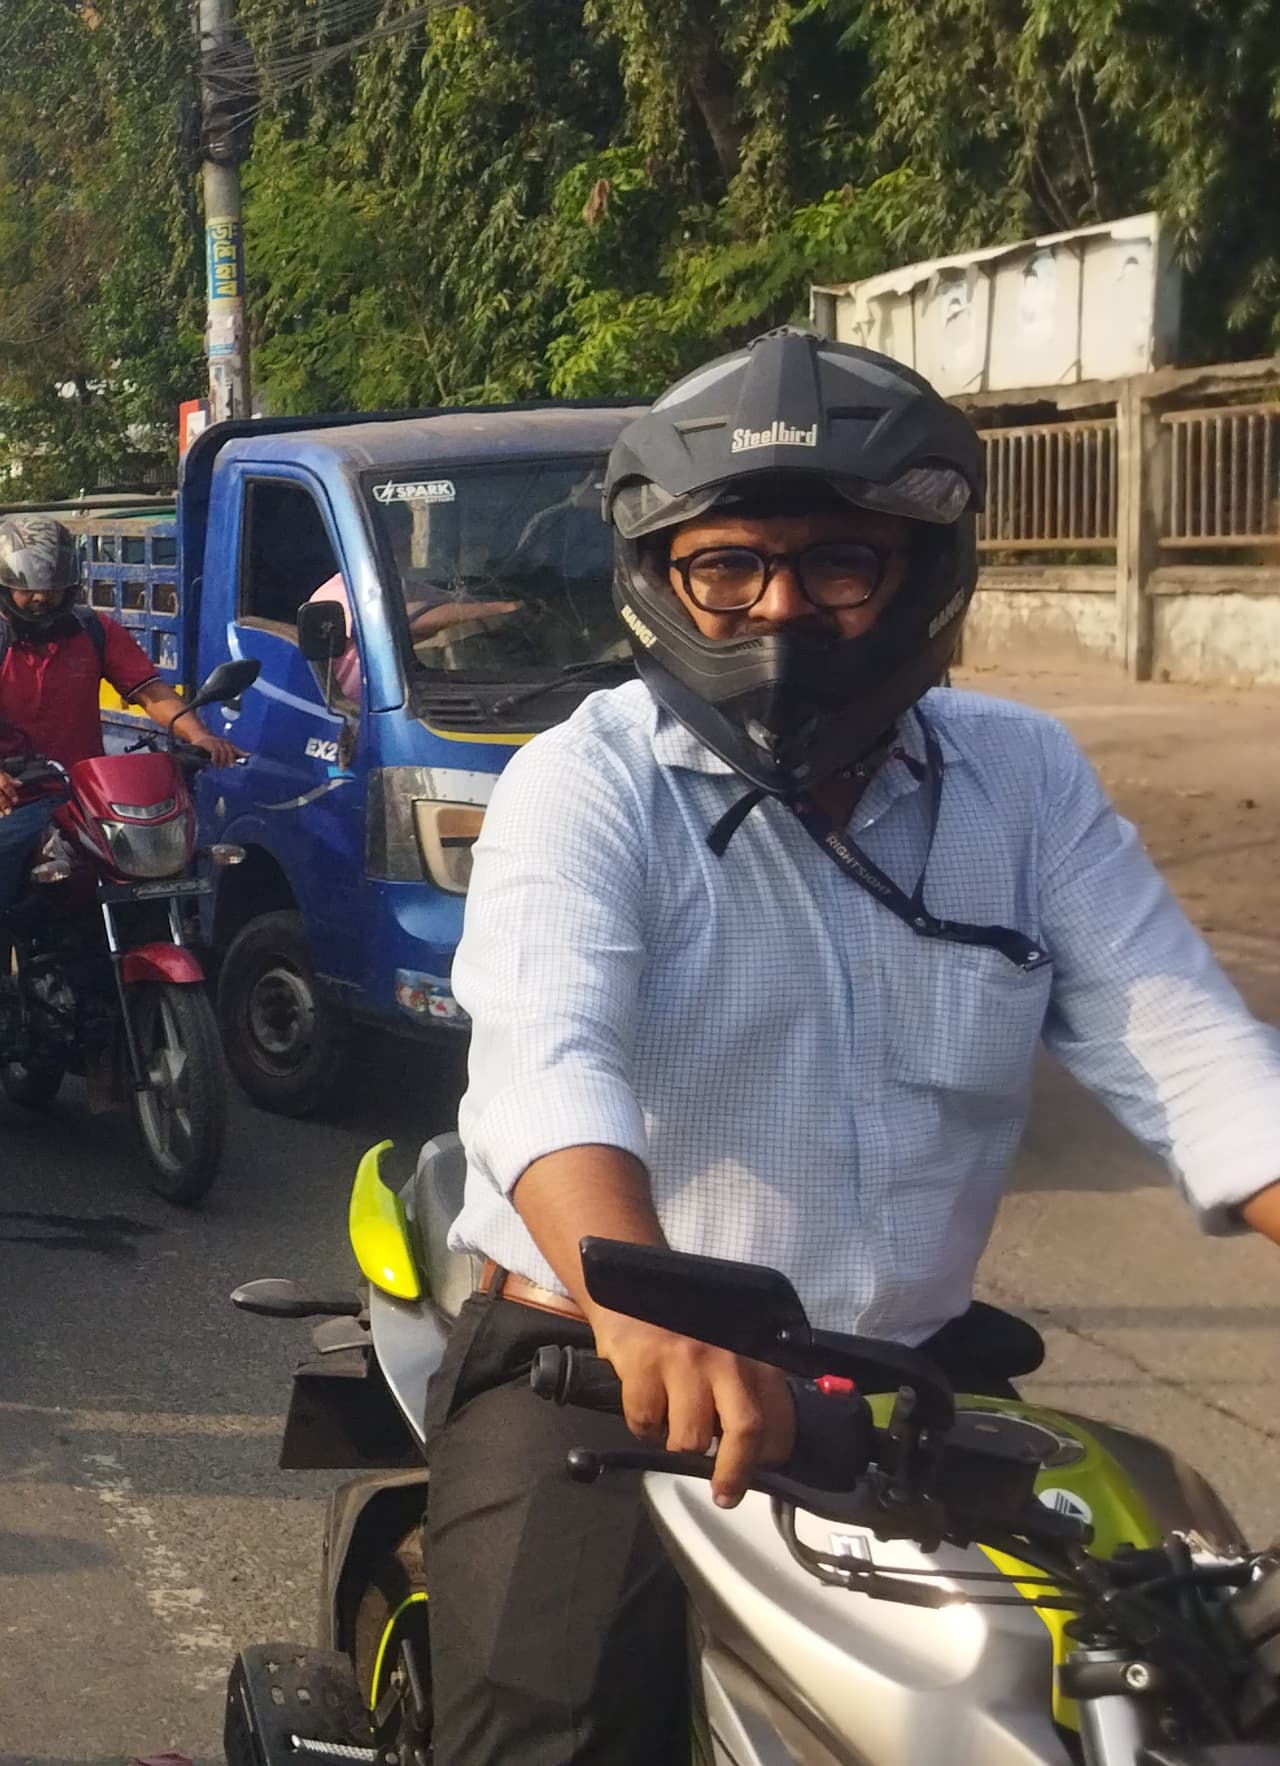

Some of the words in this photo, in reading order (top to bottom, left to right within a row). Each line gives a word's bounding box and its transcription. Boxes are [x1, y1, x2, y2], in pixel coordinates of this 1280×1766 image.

[731, 421, 818, 450] Steelbird
[397, 484, 450, 498] SPARK
[304, 736, 339, 762] EX2
